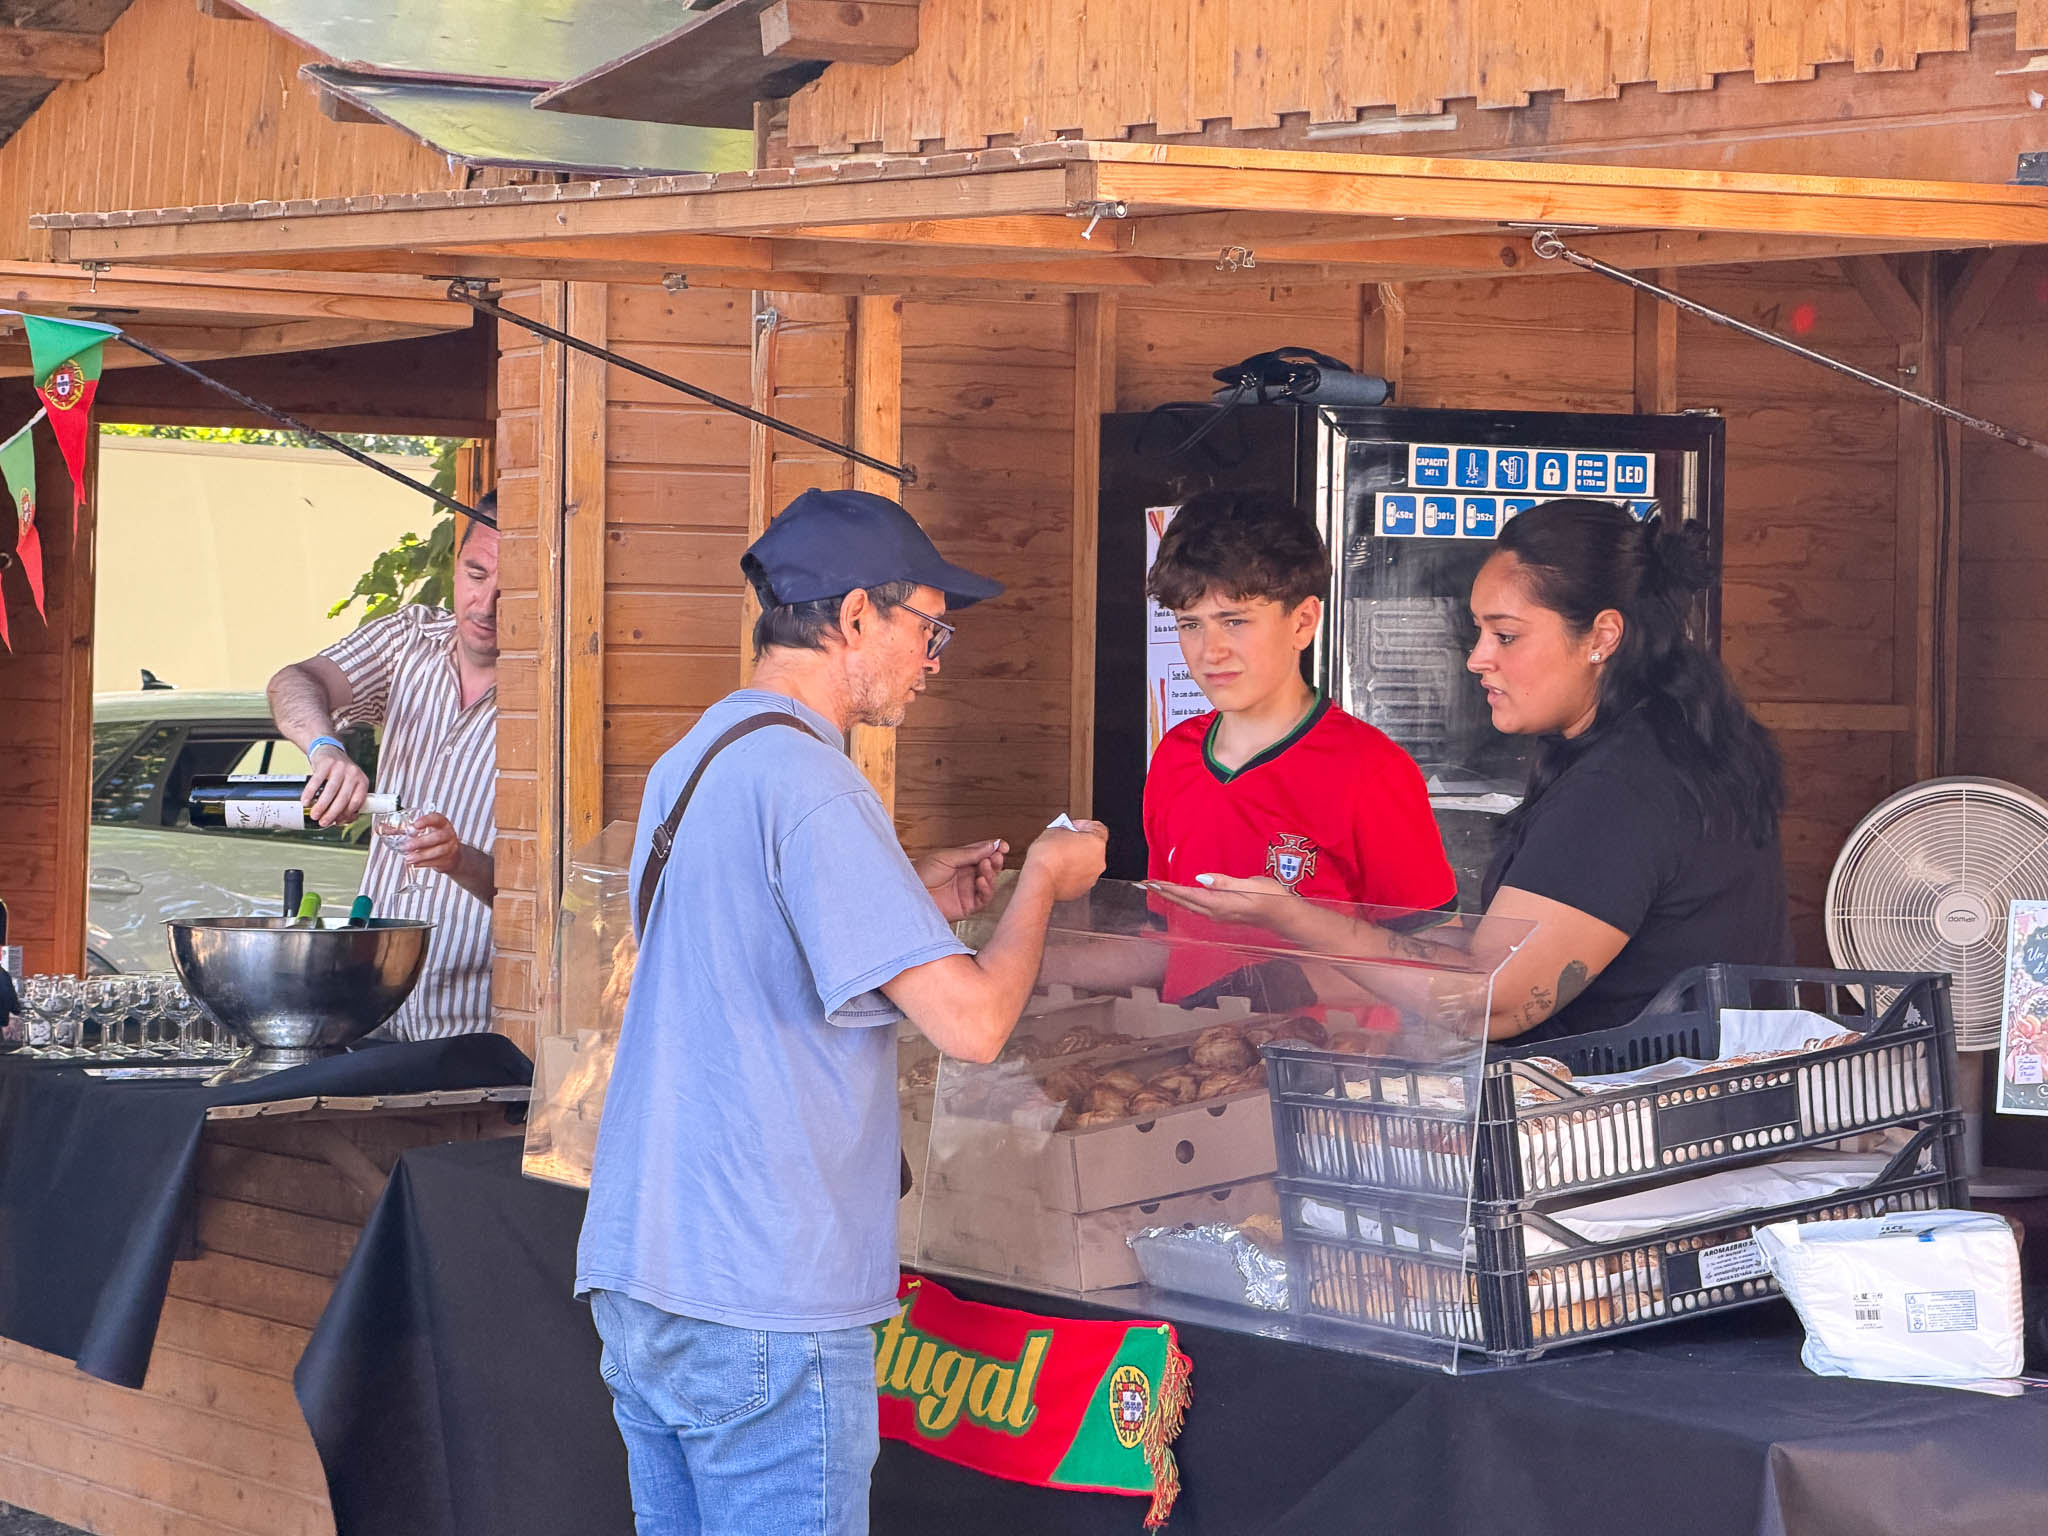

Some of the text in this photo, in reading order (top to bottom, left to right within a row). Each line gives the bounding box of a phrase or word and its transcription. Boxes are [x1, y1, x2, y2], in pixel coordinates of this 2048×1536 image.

[1416, 457, 1449, 467] CAPACITY
[1617, 465, 1644, 484] LED
[1704, 1241, 1748, 1257] AROMAEBRO
[873, 1304, 1047, 1430] tugal
